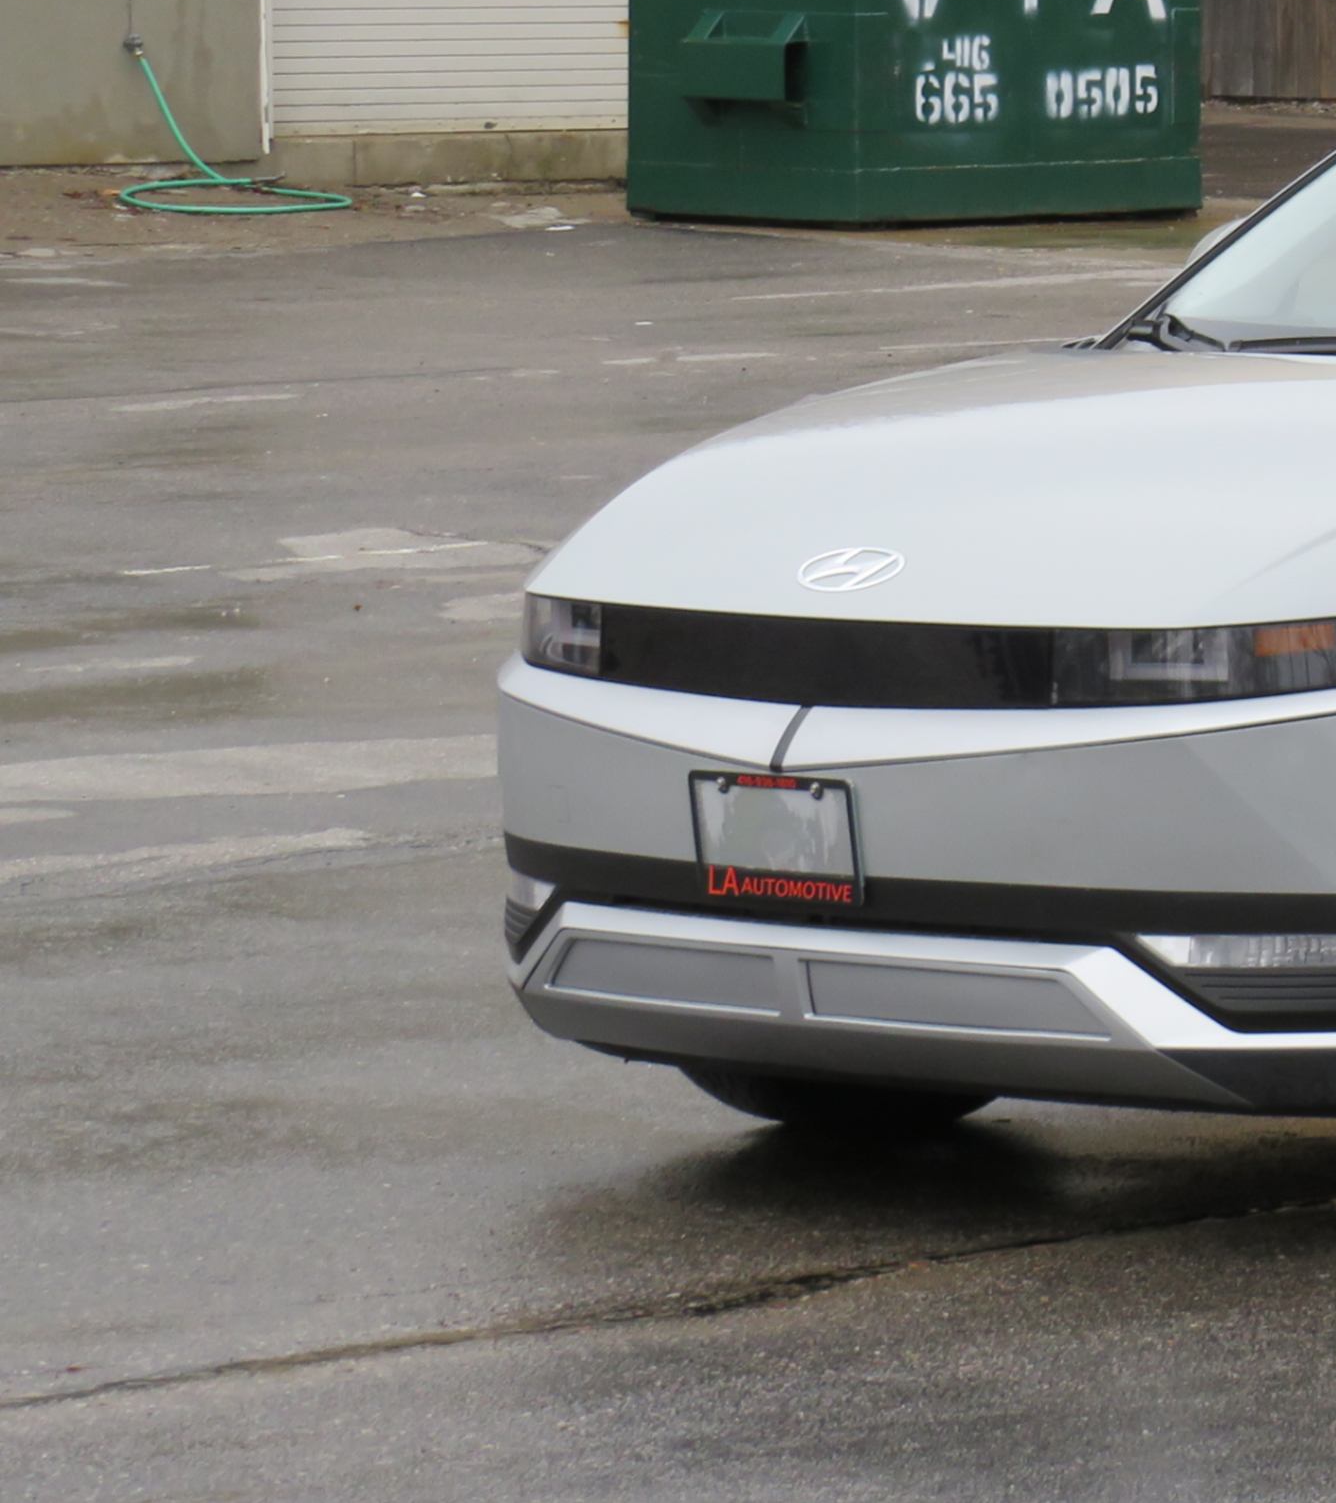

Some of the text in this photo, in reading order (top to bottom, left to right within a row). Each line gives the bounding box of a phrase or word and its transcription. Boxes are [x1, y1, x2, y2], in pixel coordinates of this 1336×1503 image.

[942, 35, 991, 71] 416
[916, 64, 1158, 124] 665 0505
[708, 865, 853, 903] LA AUTOMOTIVE
